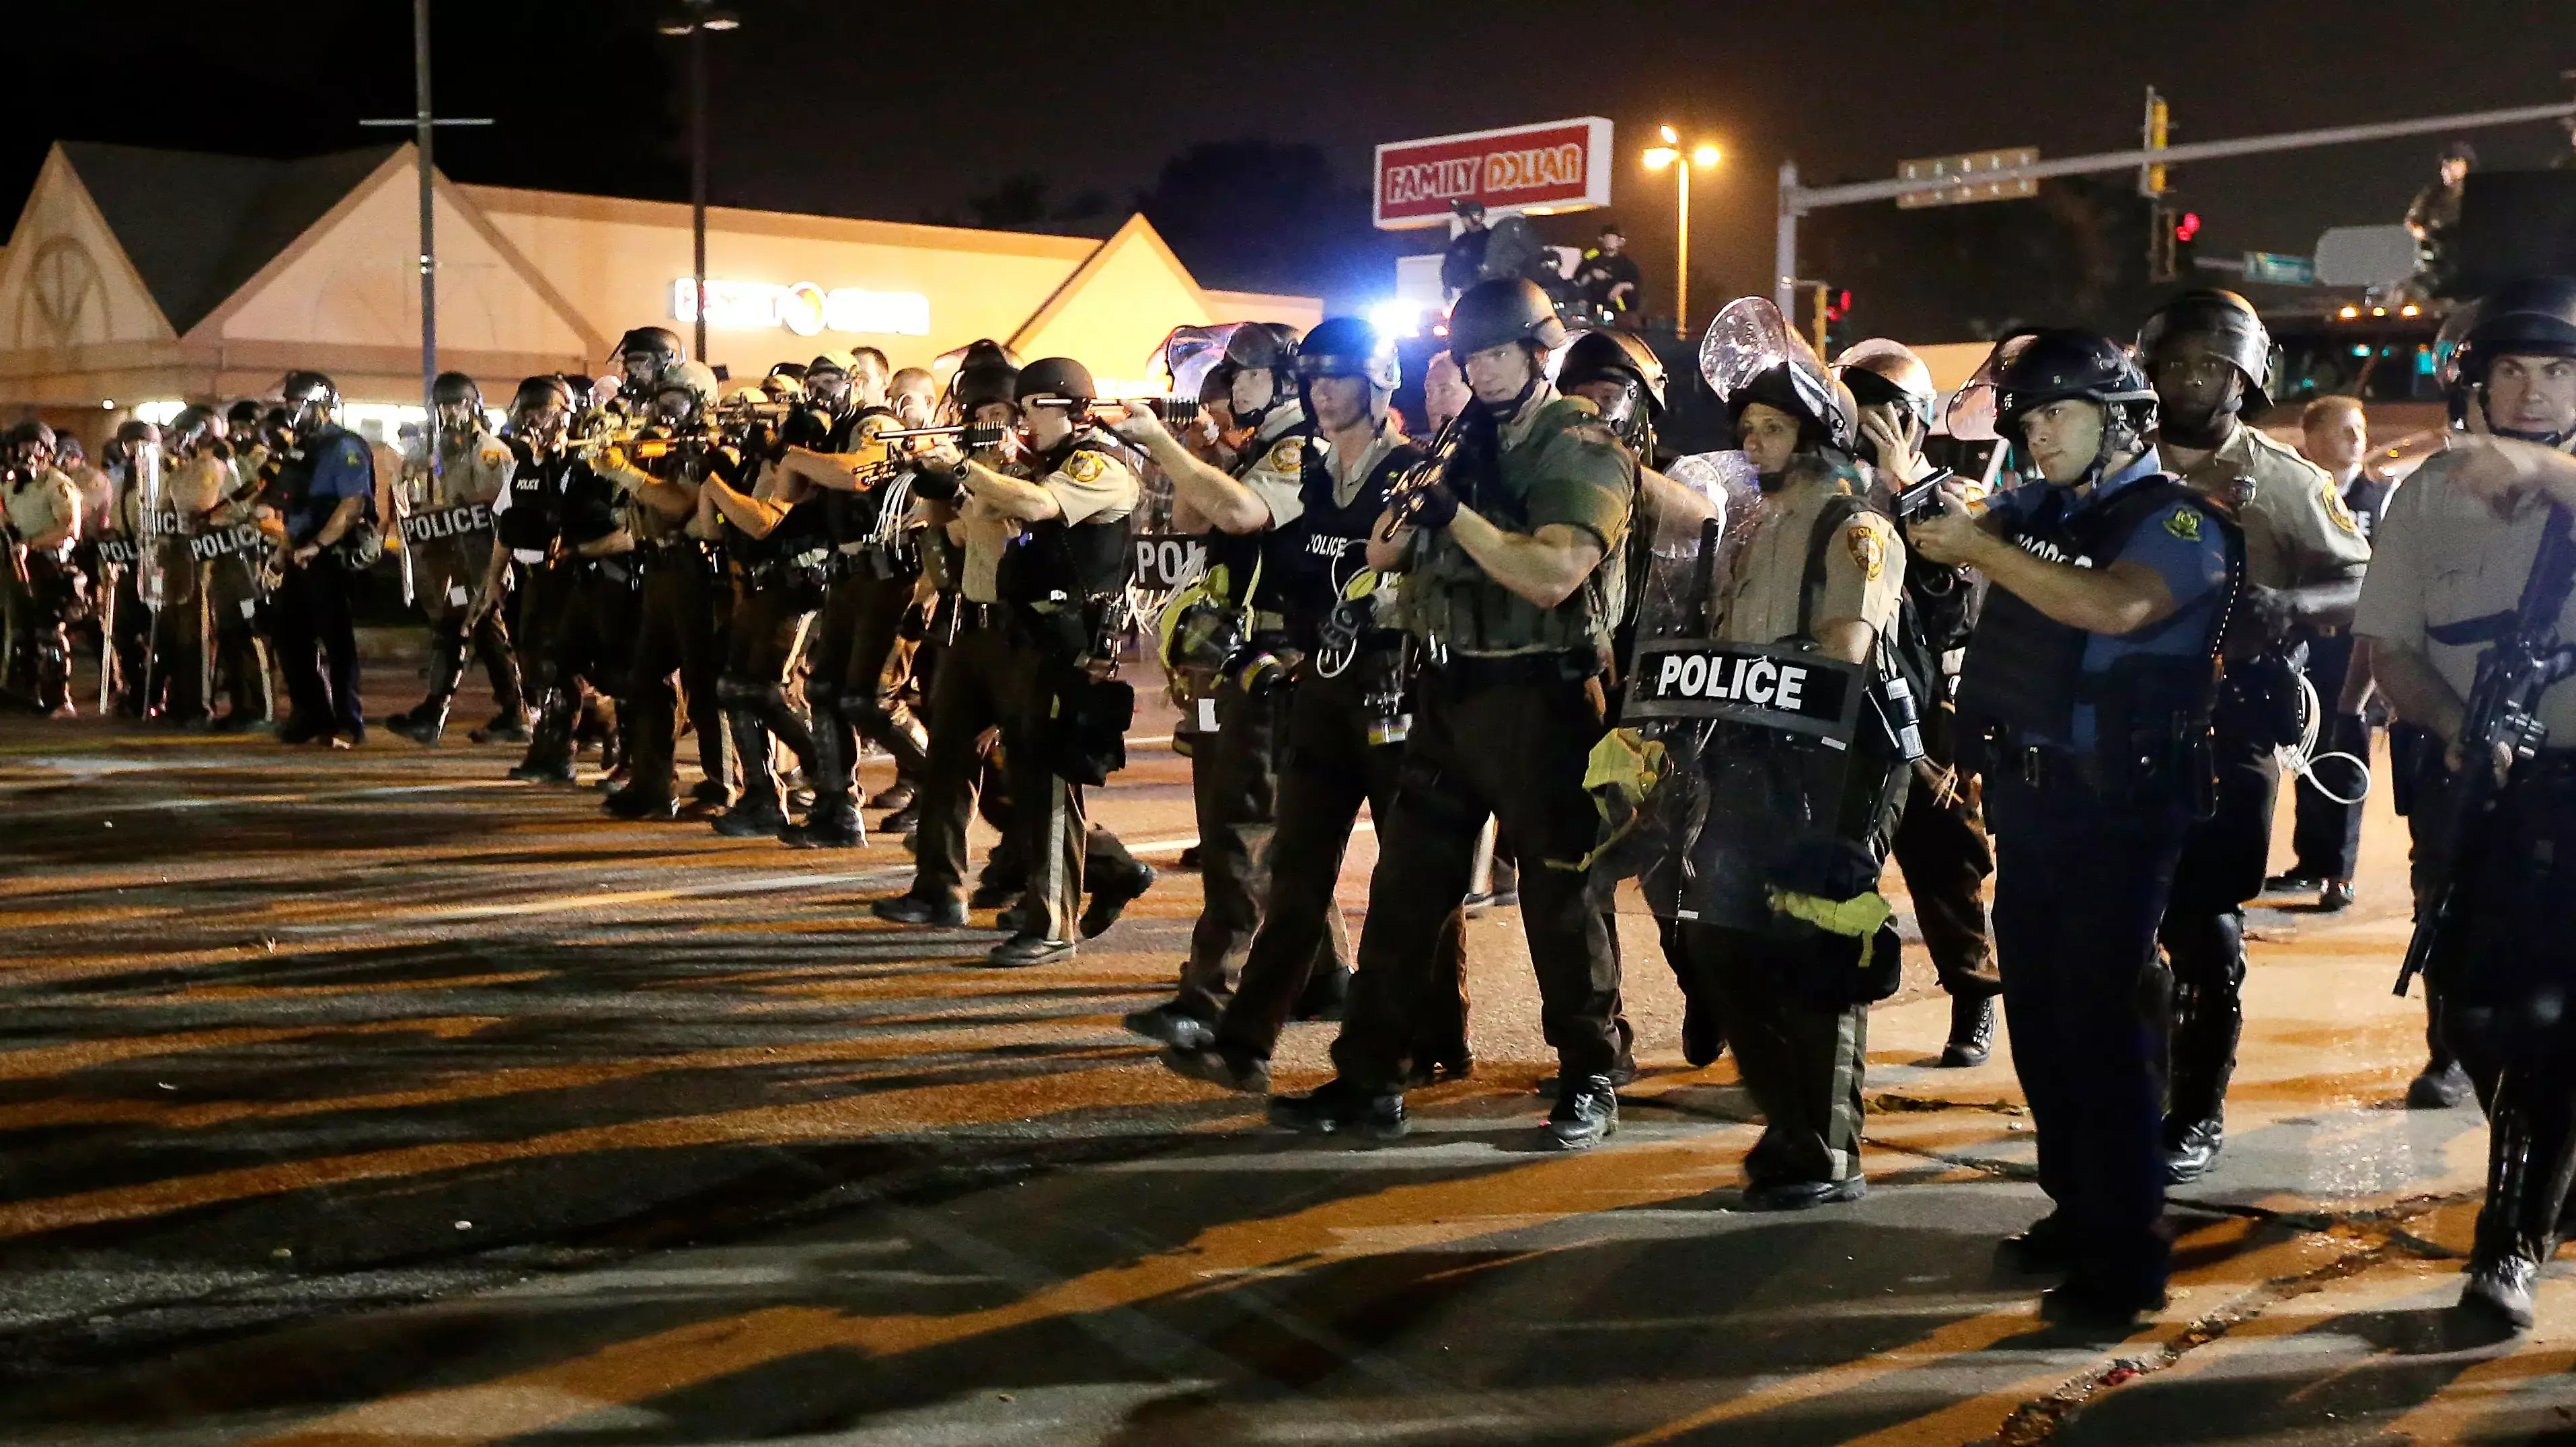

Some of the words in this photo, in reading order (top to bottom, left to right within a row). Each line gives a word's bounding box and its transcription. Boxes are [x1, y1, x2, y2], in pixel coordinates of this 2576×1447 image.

[1386, 157, 1480, 204] FAMILY
[1484, 143, 1582, 192] DOLLAR
[516, 478, 540, 491] POLICE
[404, 505, 489, 541] POLICE
[98, 541, 137, 563] POL
[1657, 655, 1808, 710] POLICE
